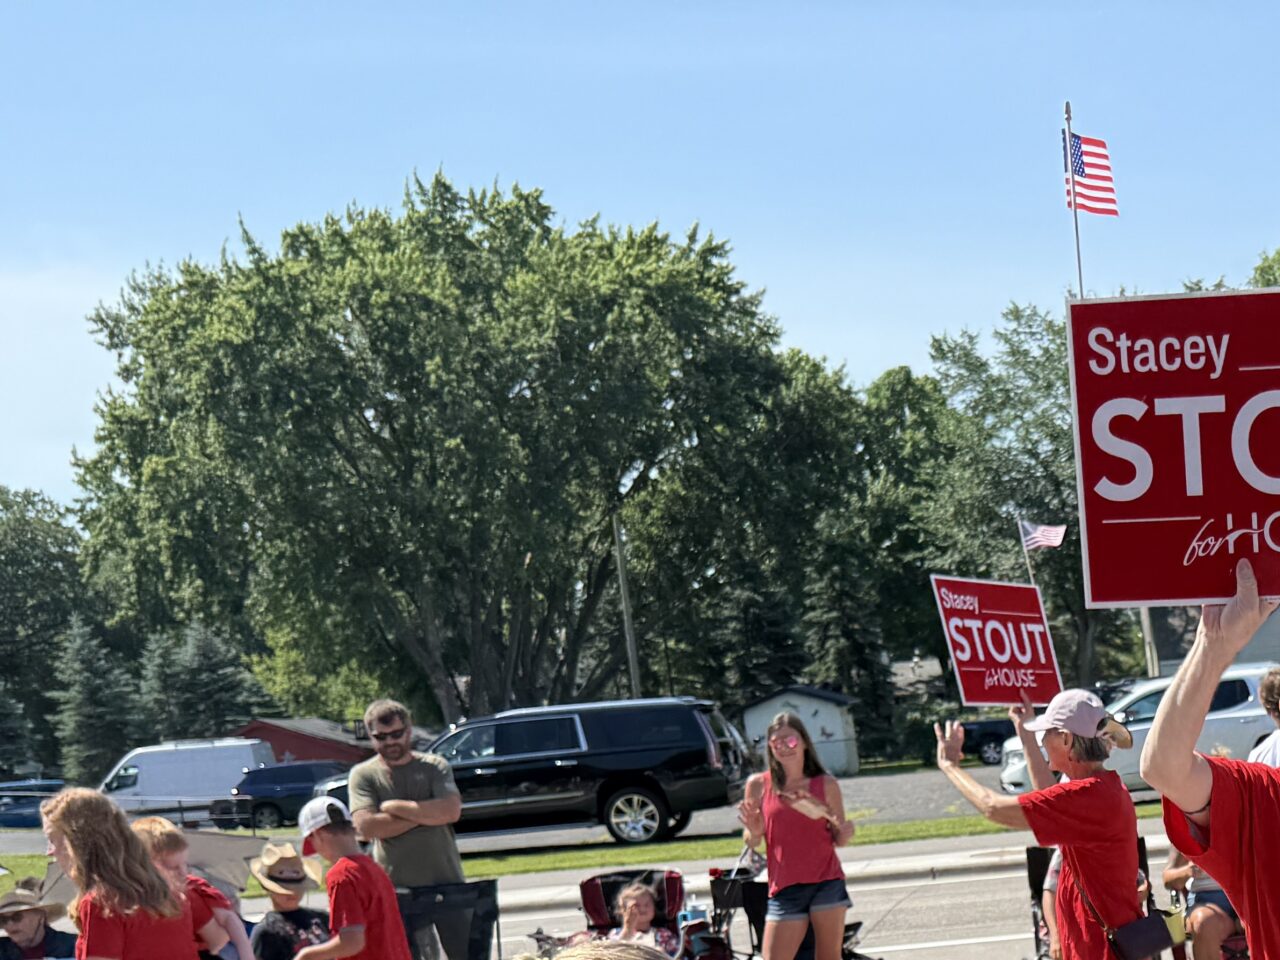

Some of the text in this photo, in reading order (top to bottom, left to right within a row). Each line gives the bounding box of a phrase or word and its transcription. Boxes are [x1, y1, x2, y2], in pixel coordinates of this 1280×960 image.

[1087, 325, 1230, 380] Stacey
[1183, 518, 1244, 566] for
[940, 587, 979, 615] Stacey
[948, 618, 1046, 664] STOUT
[992, 669, 1037, 688] HOUSE
